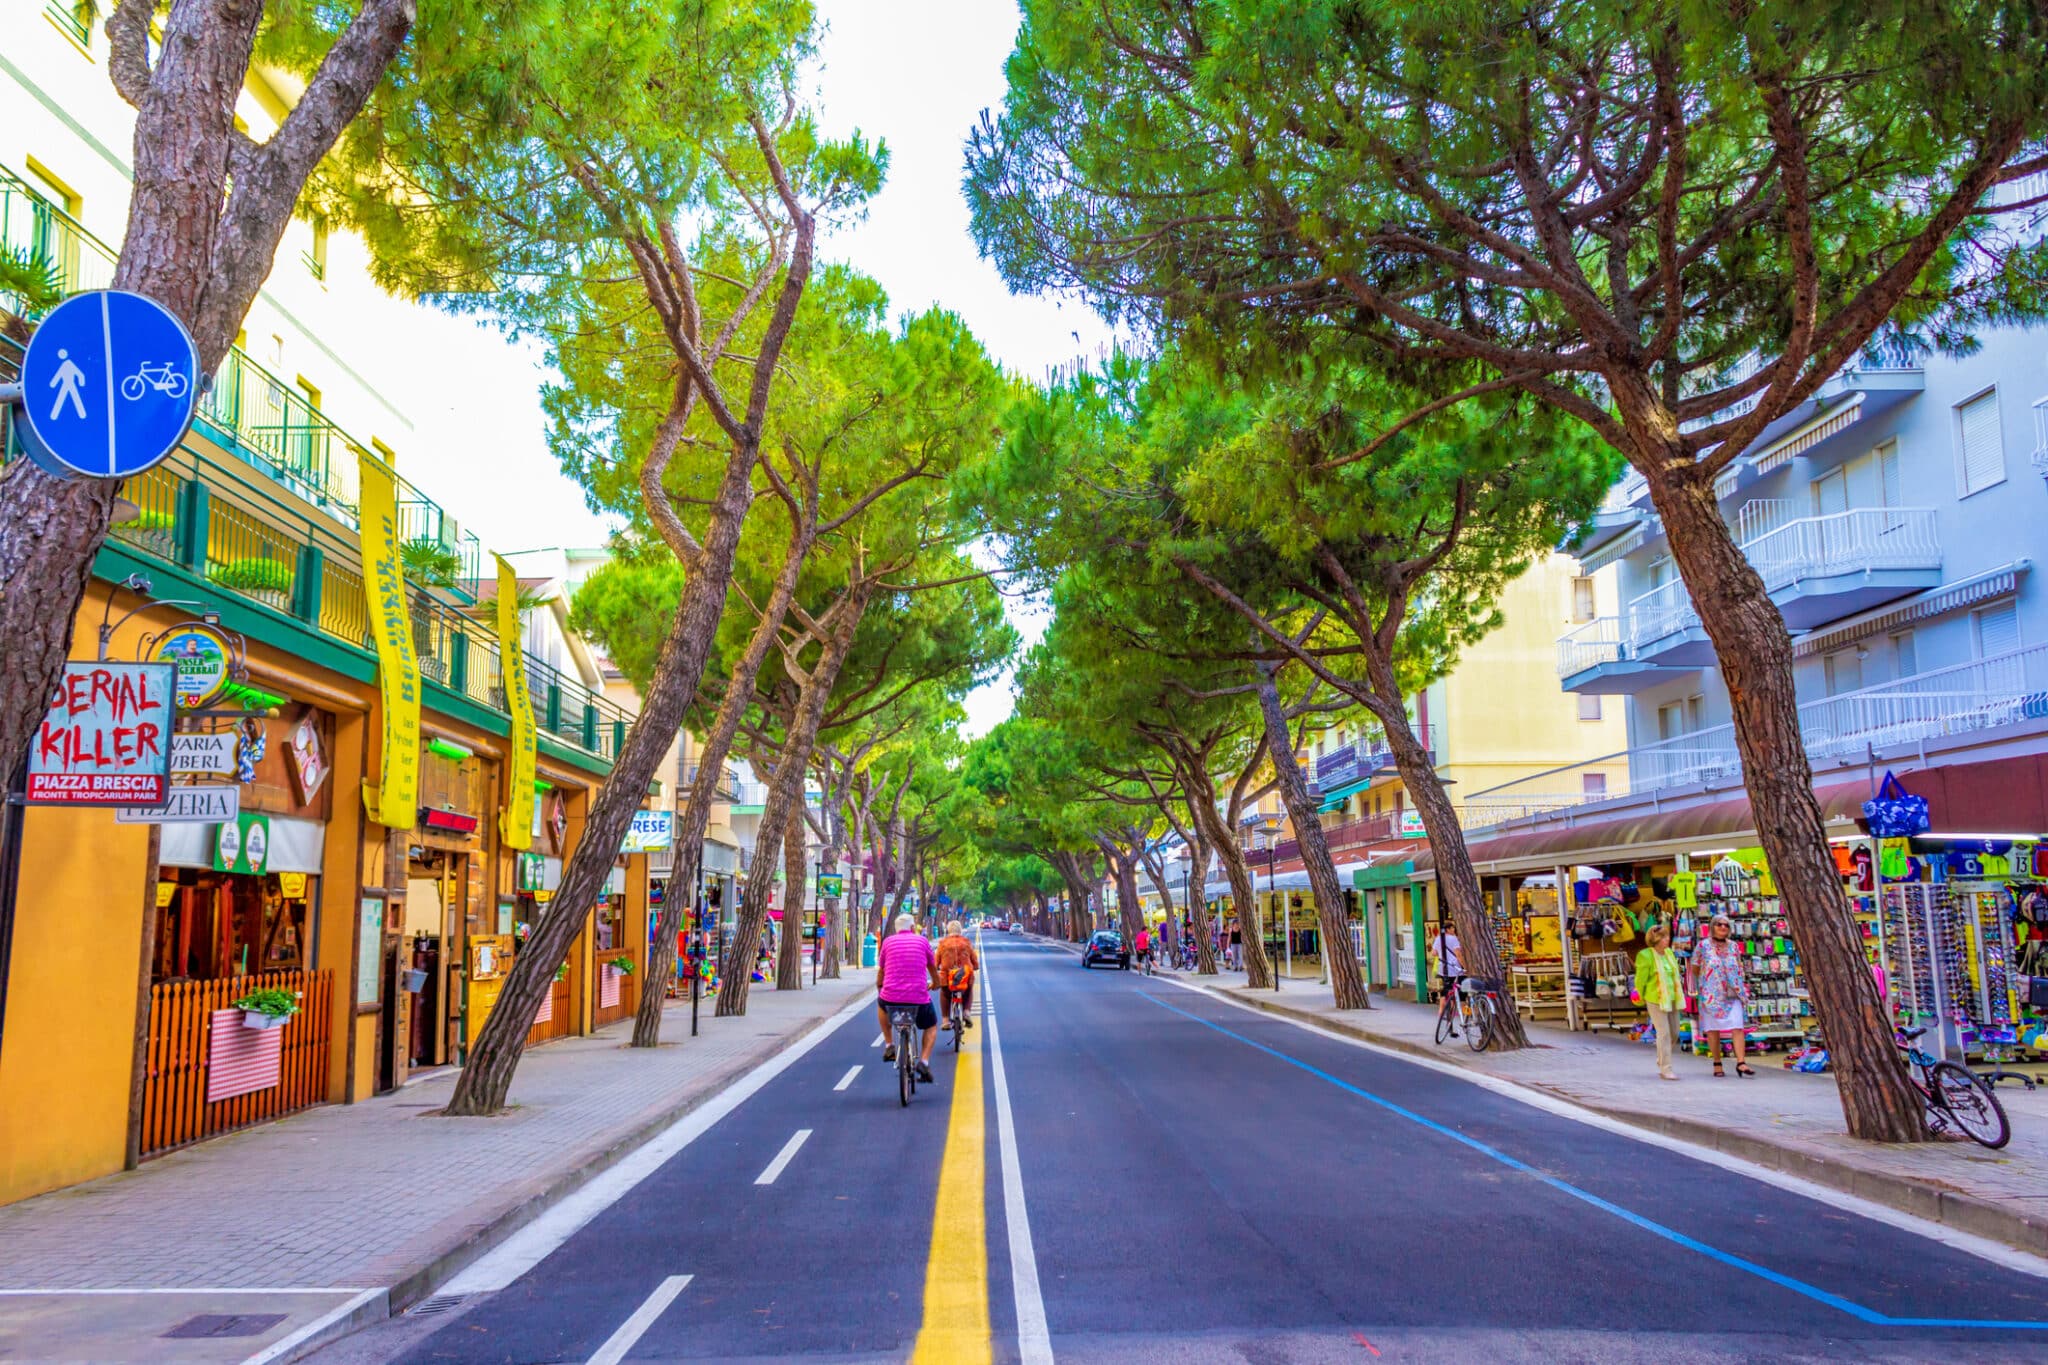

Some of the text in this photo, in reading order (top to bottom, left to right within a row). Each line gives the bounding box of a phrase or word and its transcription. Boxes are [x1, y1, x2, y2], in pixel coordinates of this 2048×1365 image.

[40, 722, 160, 772] KILLER
[172, 738, 223, 750] VARIA
[34, 775, 157, 790] PIAZZA BRESCIA
[33, 791, 67, 799] FRONTE
[72, 791, 132, 799] TROPICARIUM
[1857, 862, 1866, 883] 9
[1965, 859, 1977, 876] 9
[2016, 856, 2027, 873] 13
